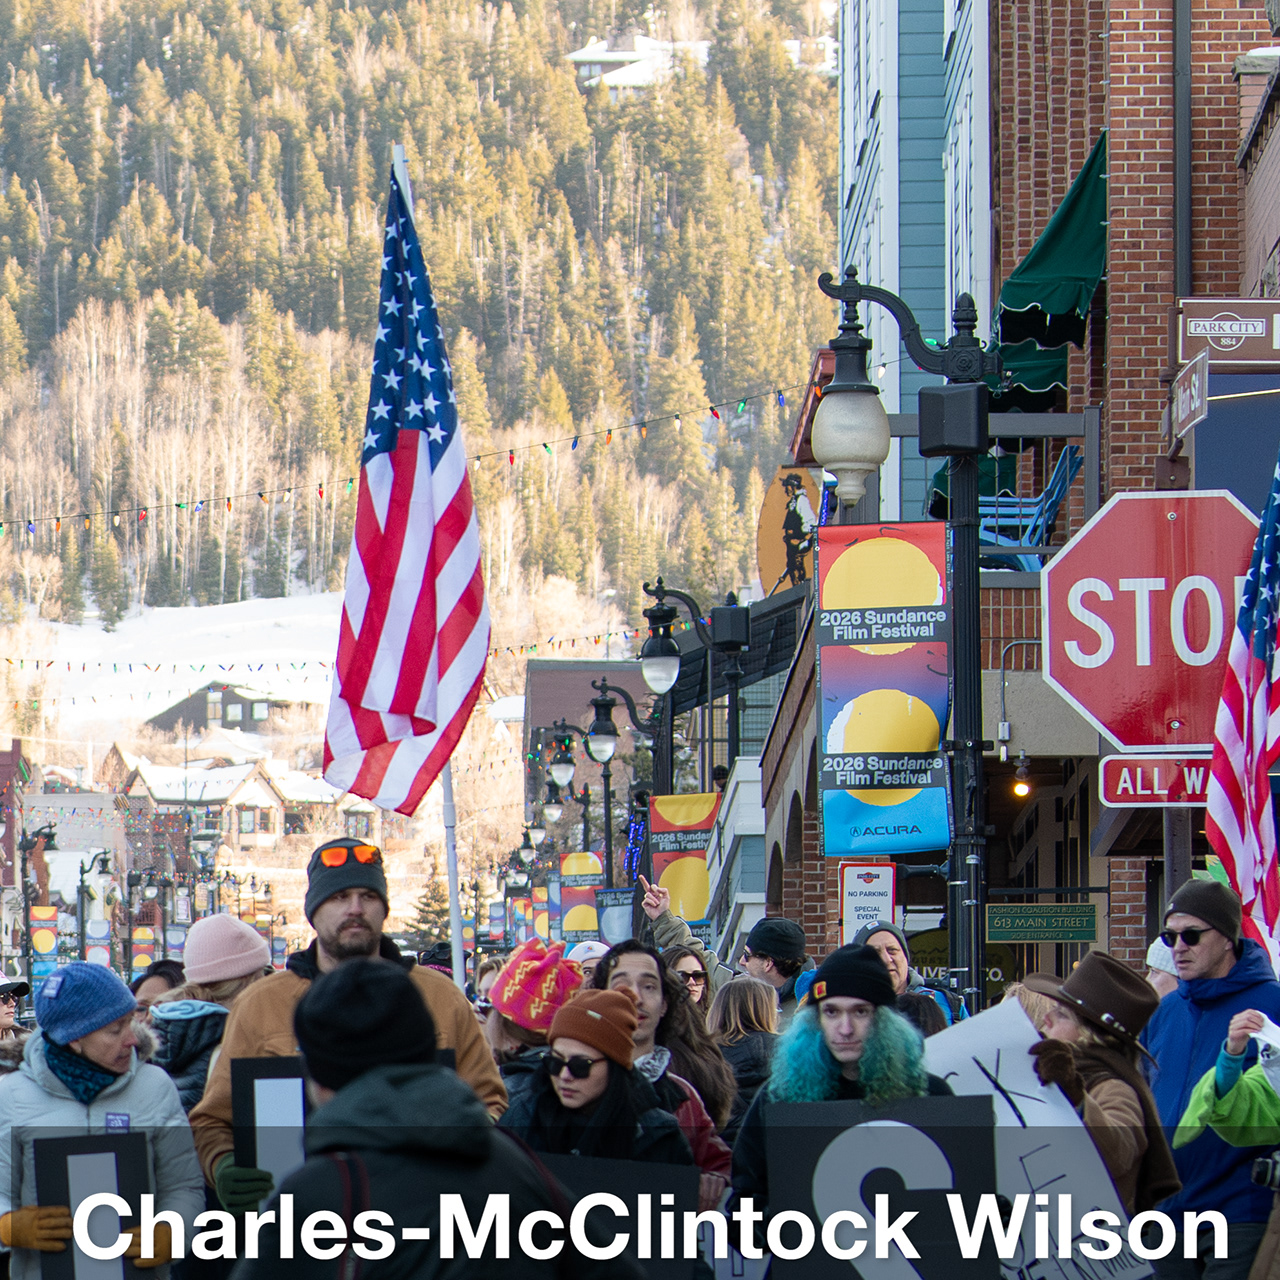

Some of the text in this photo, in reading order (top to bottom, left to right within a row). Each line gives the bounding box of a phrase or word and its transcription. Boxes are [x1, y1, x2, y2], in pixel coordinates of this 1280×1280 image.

[1193, 322, 1260, 333] PARK CITY
[1220, 337, 1236, 346] 884
[820, 610, 947, 626] 2026 Sundance
[1063, 575, 1247, 669] STO
[833, 623, 934, 640] Film Festival
[822, 755, 943, 771] 2026 Sundance
[835, 770, 932, 786] Film Festival
[1116, 767, 1168, 796] ALL
[862, 824, 923, 836] ACURA
[652, 834, 676, 844] 2026
[659, 842, 679, 850] Film
[993, 916, 1089, 928] 613 MAIN STREET
